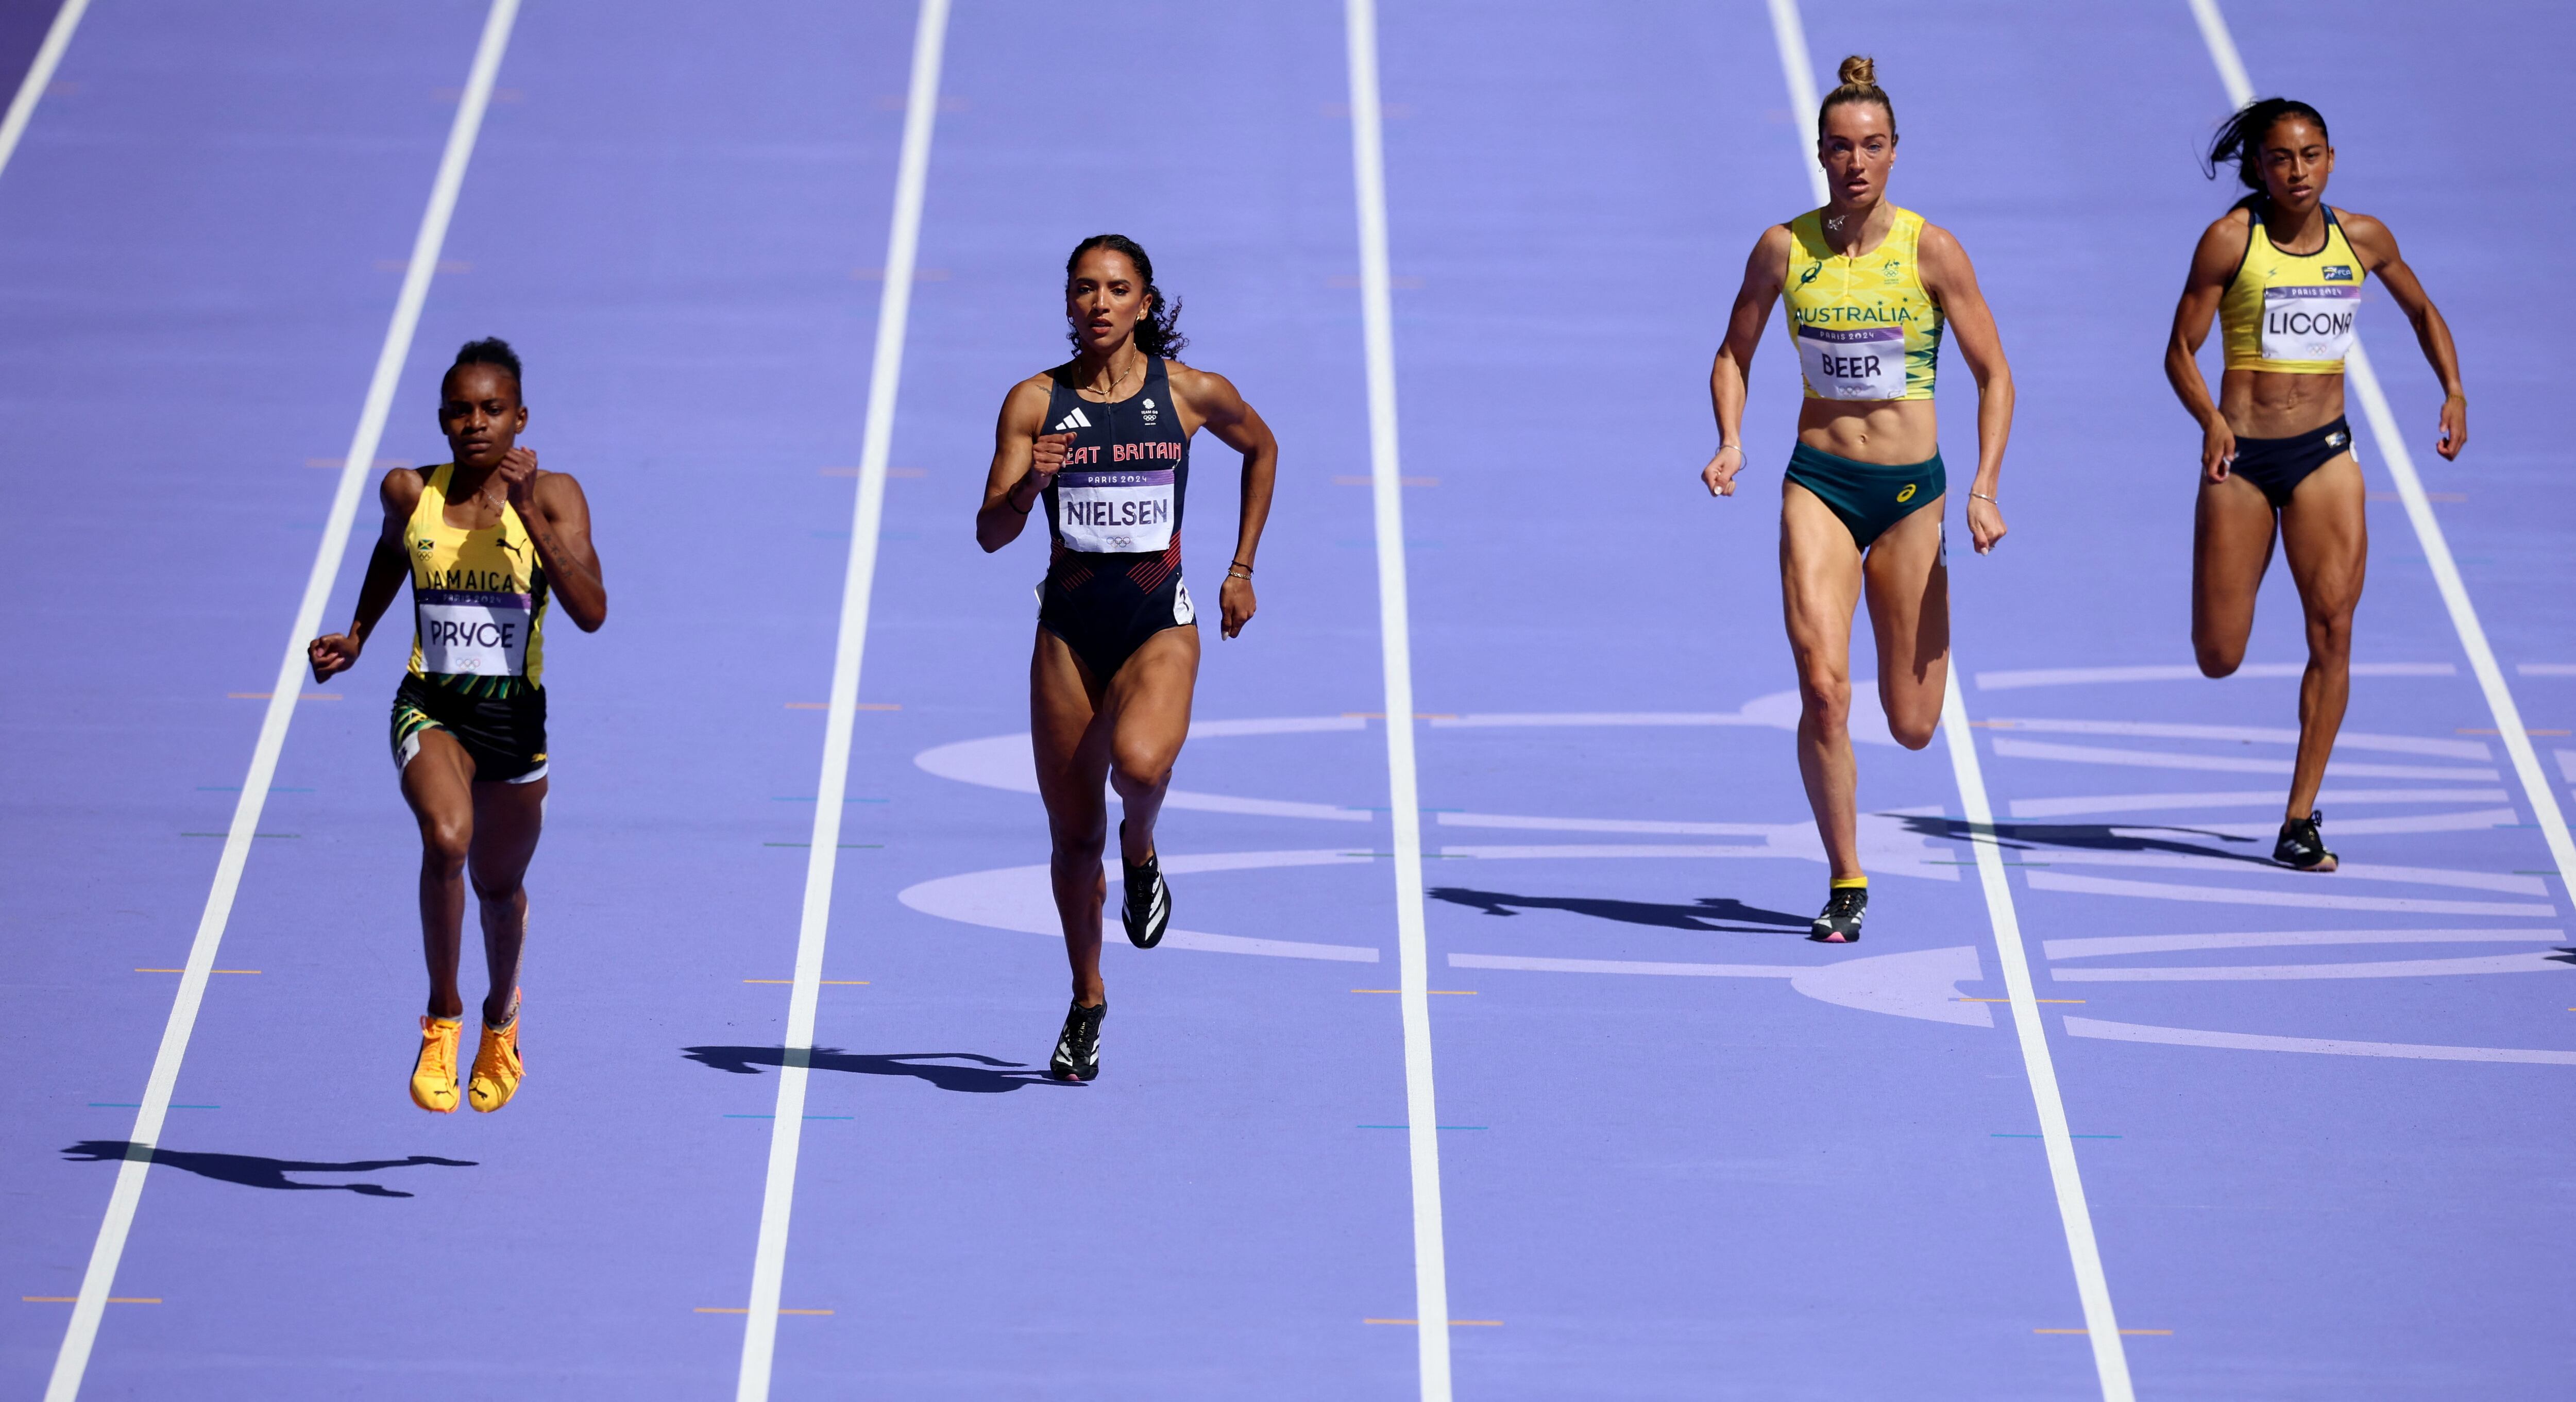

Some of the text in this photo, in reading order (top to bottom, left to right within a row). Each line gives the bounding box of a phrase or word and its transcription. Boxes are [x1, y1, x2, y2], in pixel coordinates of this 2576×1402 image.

[1794, 307, 1912, 322] AUSTRALIA
[2269, 312, 2352, 335] LICONA
[1820, 331, 1874, 340] PARIS 2024
[1822, 353, 1881, 378] BEER
[1064, 442, 1181, 465] EAT BRITAIN
[1067, 499, 1167, 526] NIELSEN
[426, 570, 515, 592] JAMAICA
[443, 594, 501, 603] PARIS 2024
[431, 620, 515, 648] PRYCE
